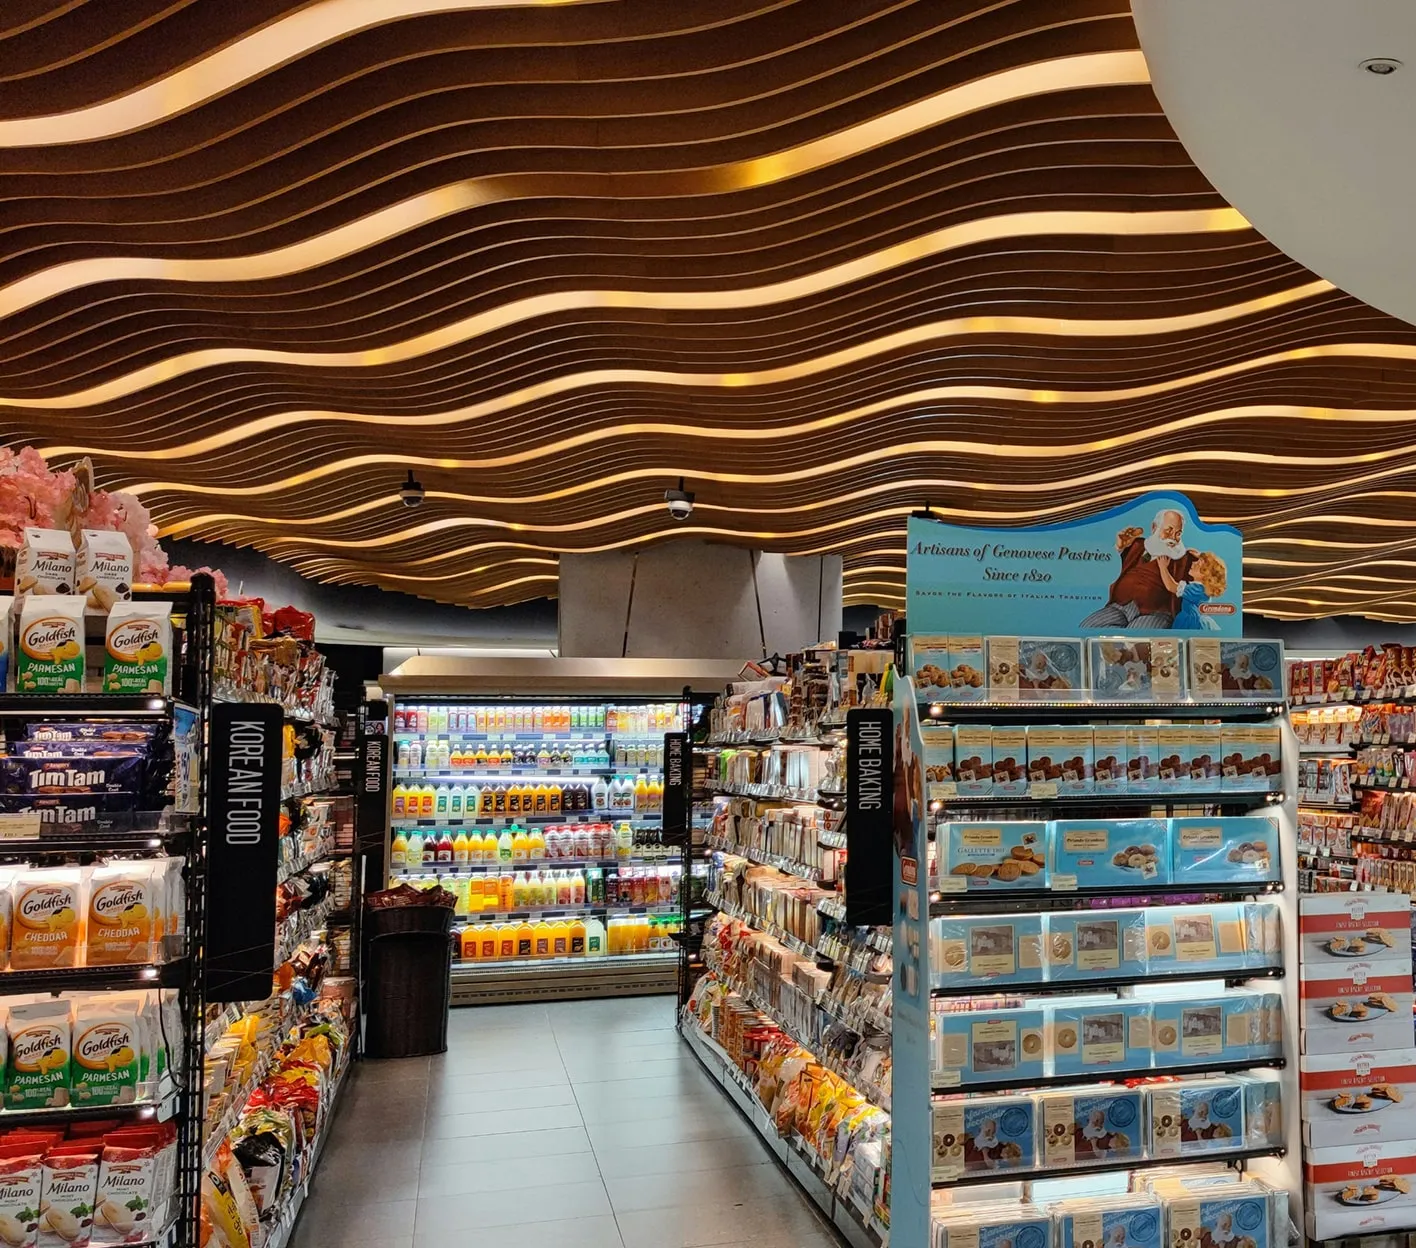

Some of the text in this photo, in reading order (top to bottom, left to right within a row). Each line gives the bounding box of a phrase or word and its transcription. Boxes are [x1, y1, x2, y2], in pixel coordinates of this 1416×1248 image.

[910, 541, 1112, 562] Artisans of Genovese Pastries
[31, 560, 72, 573] Milano
[90, 560, 130, 572] Milano
[983, 567, 1052, 582] Since 1820
[28, 627, 76, 647] Goldfish
[113, 629, 159, 648] Goldfish
[27, 663, 76, 674] PARMESAN
[112, 664, 158, 675] PARMESAN
[365, 741, 381, 792] KOREAN FOOD
[669, 738, 681, 786] HOME BAKING
[859, 721, 881, 809] HOME BAKING
[226, 721, 265, 844] KOREAN FOOD
[23, 895, 72, 915] Goldfish
[96, 890, 144, 911] Goldfish
[24, 931, 68, 942] CHEDDAR
[97, 927, 140, 938] CHEDDAR
[16, 1035, 61, 1057] Goldfish
[82, 1032, 130, 1056] Goldfish
[14, 1071, 64, 1085] PARMESAN
[82, 1069, 130, 1082] PARMESAN
[46, 1183, 90, 1195] Milano
[101, 1176, 145, 1188] Milano
